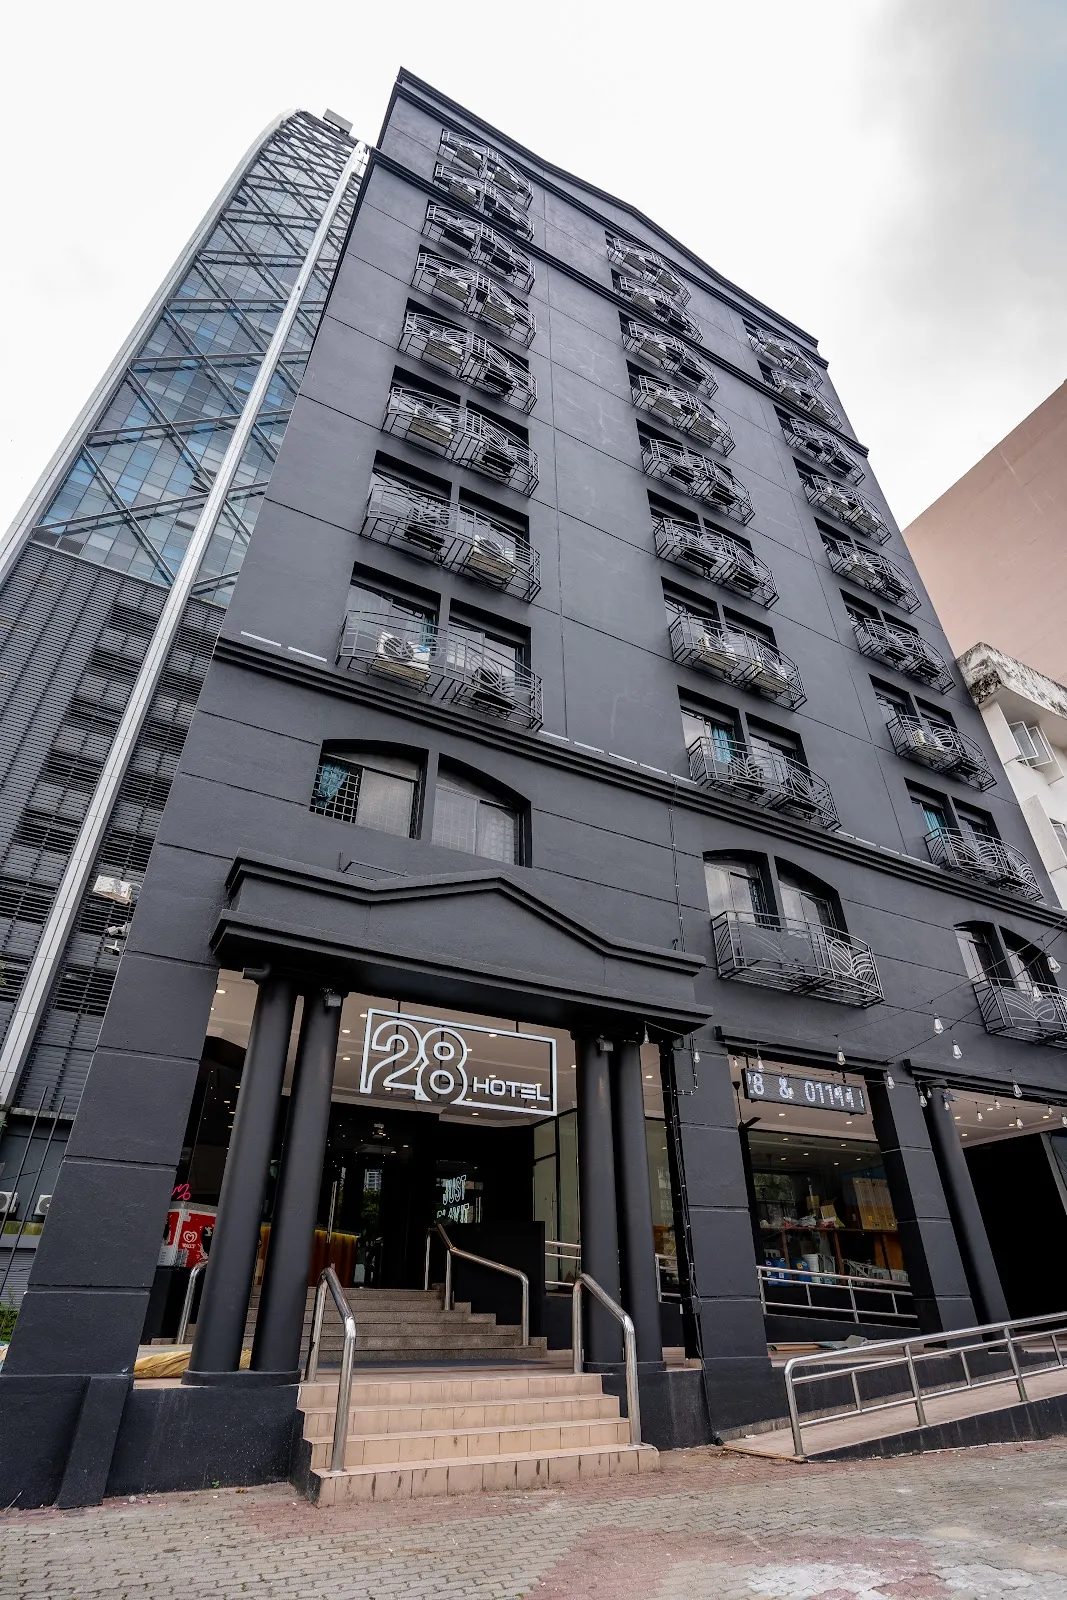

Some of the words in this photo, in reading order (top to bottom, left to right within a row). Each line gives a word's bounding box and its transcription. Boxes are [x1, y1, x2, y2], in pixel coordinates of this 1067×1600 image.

[367, 1019, 468, 1103] 28
[472, 1076, 550, 1102] HOTEL
[778, 1076, 793, 1099] &
[442, 1174, 467, 1205] JUST
